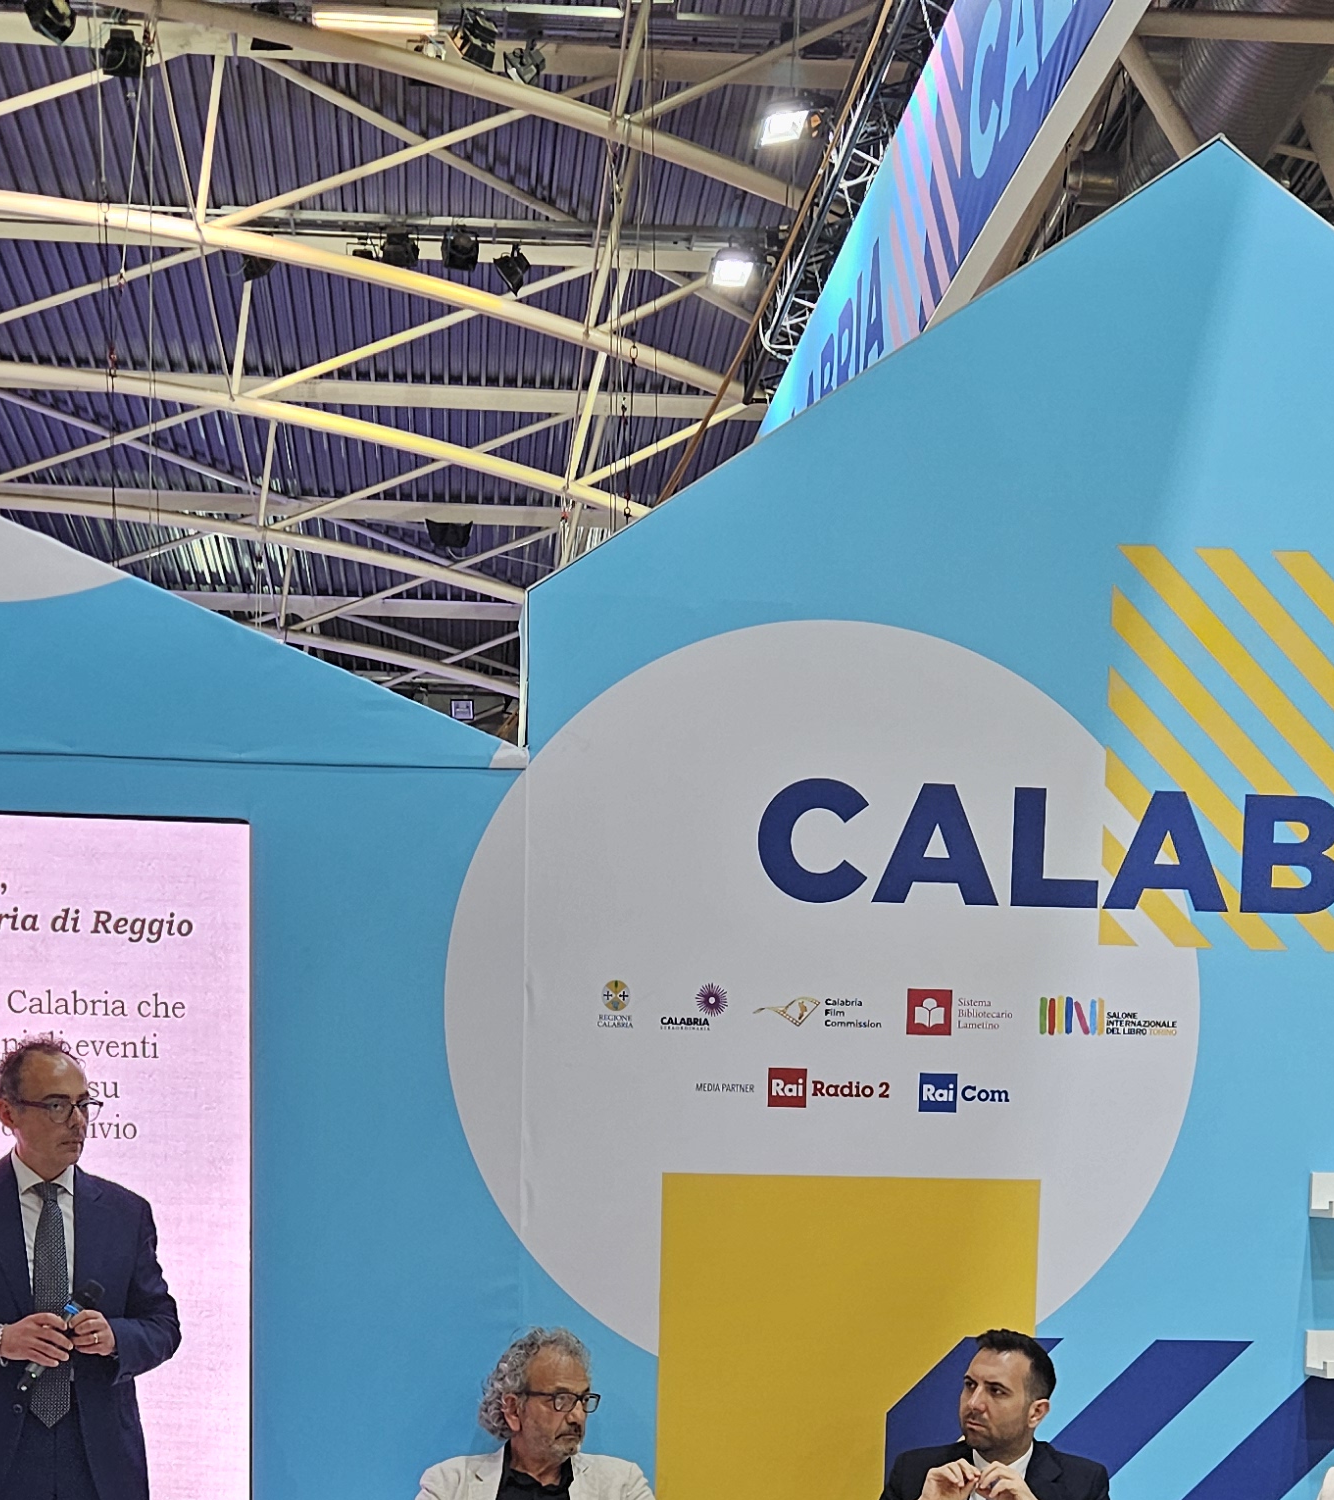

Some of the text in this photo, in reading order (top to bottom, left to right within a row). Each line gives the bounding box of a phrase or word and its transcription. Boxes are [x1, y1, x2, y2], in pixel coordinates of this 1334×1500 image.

[50, 908, 81, 935] di
[91, 910, 194, 944] Reggio
[8, 990, 128, 1019] Calabria
[137, 992, 186, 1020] che
[825, 998, 863, 1007] Calabria
[957, 998, 992, 1007] Sistema
[825, 1008, 845, 1017] Film
[957, 1009, 1013, 1019] Bibliotecario
[599, 1014, 632, 1022] REGIONE
[660, 1017, 709, 1026] CALABRIA
[824, 1019, 882, 1029] Commission
[957, 1020, 999, 1030] Lametino
[1106, 1020, 1177, 1028] INTERNAZIONALE
[1149, 1028, 1177, 1036] TORINO
[74, 1035, 159, 1061] eventi
[87, 1077, 120, 1100] su
[695, 1083, 755, 1093] MEDIA PARTNER
[771, 1078, 890, 1098] Rai Radio 2
[923, 1083, 1010, 1103] Rai Com
